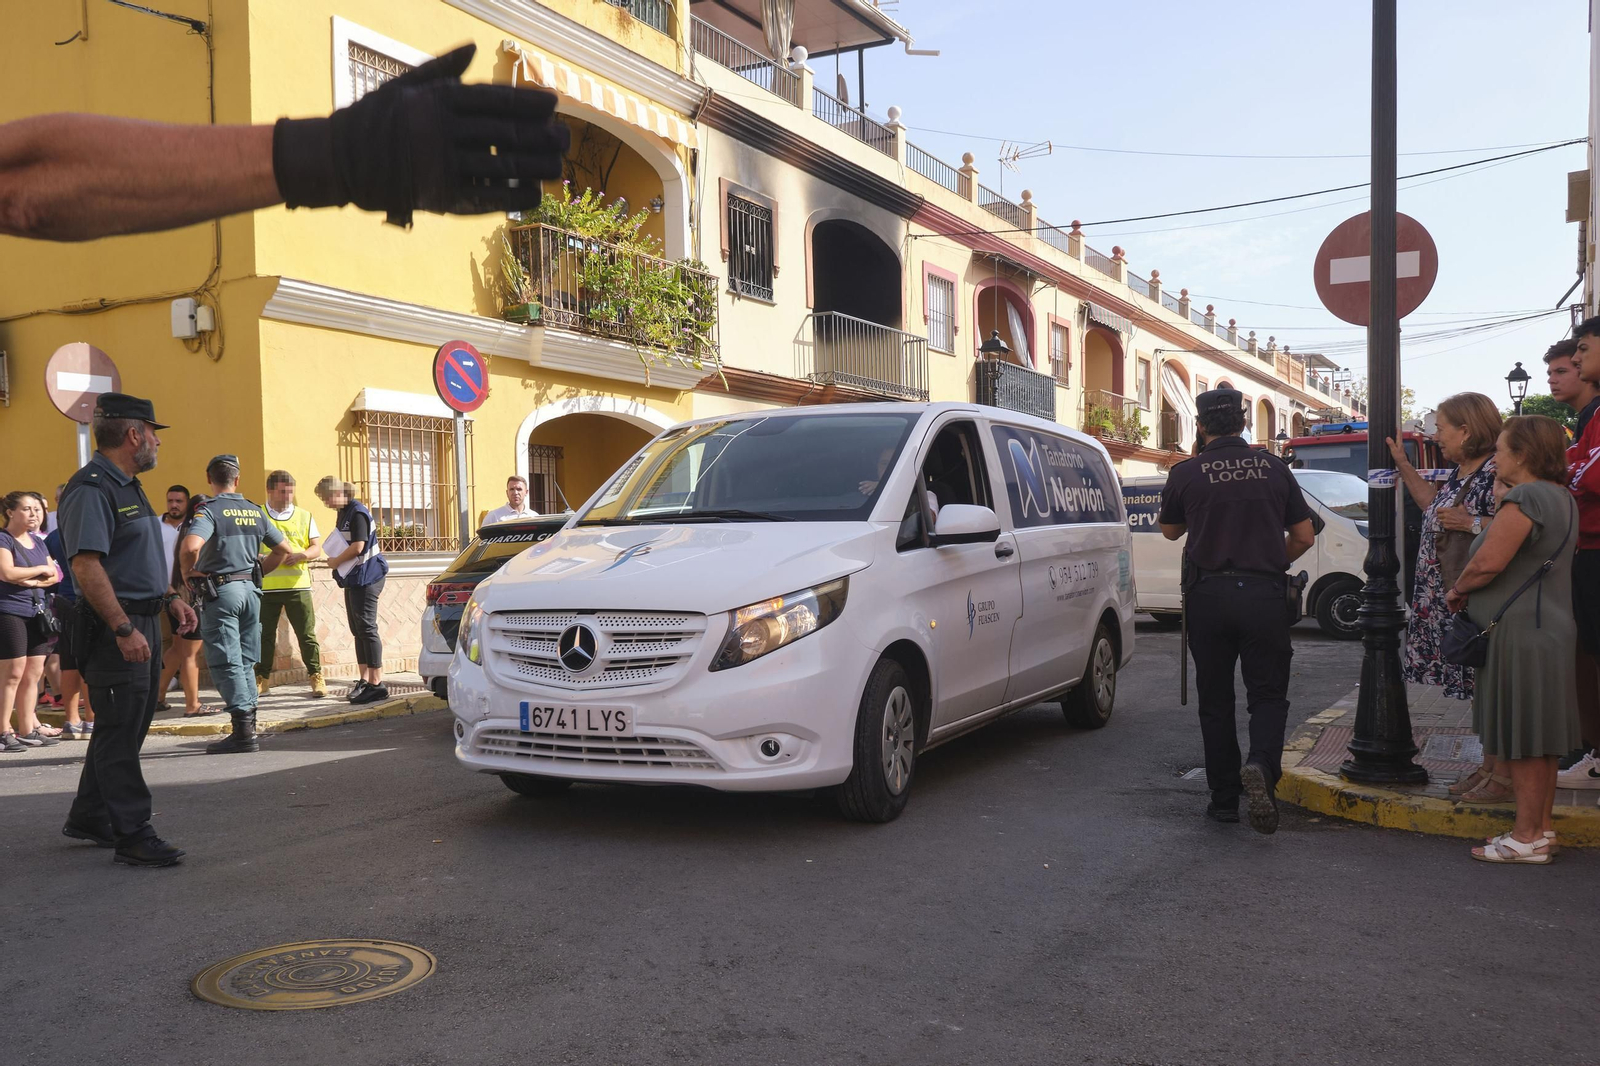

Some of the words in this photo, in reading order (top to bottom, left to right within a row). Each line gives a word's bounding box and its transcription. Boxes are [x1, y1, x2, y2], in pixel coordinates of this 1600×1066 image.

[1041, 444, 1084, 469] Tanatorio
[1209, 469, 1268, 484] LOCAL
[1050, 476, 1105, 512] Nervión
[1122, 491, 1162, 505] anatori
[223, 509, 261, 518] GUARDIA
[235, 517, 257, 526] CIVIL
[478, 533, 535, 547] GUARDIA
[977, 600, 996, 612] GRUPO
[532, 707, 577, 730] 6741
[587, 709, 627, 732] LYS
